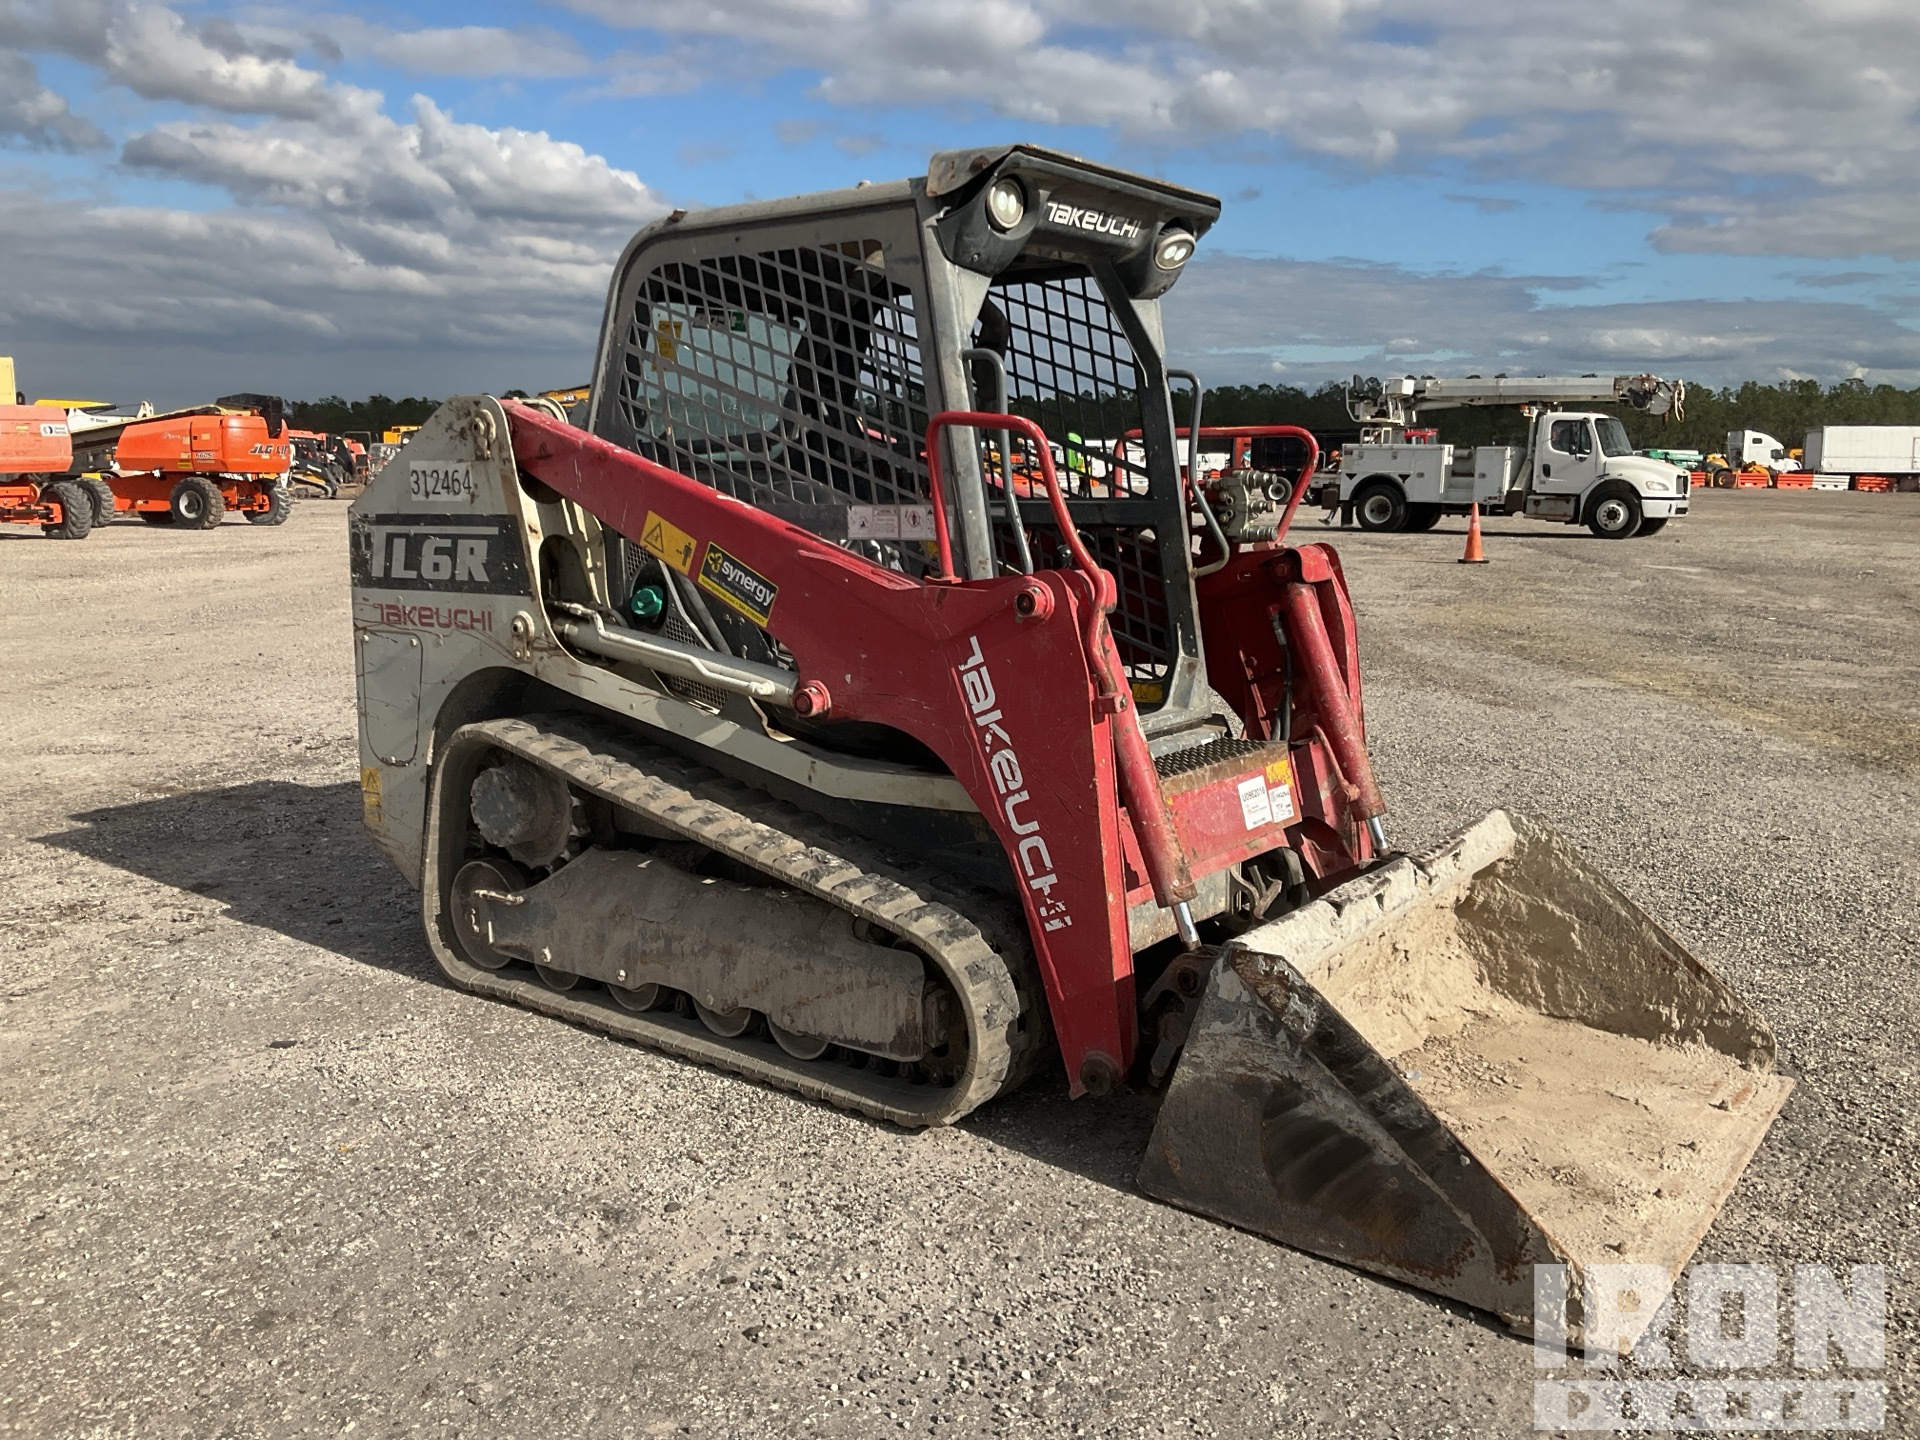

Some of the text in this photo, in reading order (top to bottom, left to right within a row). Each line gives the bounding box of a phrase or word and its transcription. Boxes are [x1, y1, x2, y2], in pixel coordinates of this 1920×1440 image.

[1047, 201, 1142, 239] TAKEUCHI
[249, 443, 273, 455] JLG
[410, 469, 471, 496] 312464
[368, 525, 499, 582] TL6R
[721, 561, 775, 606] synergy
[373, 603, 492, 631] TAKEUCHI
